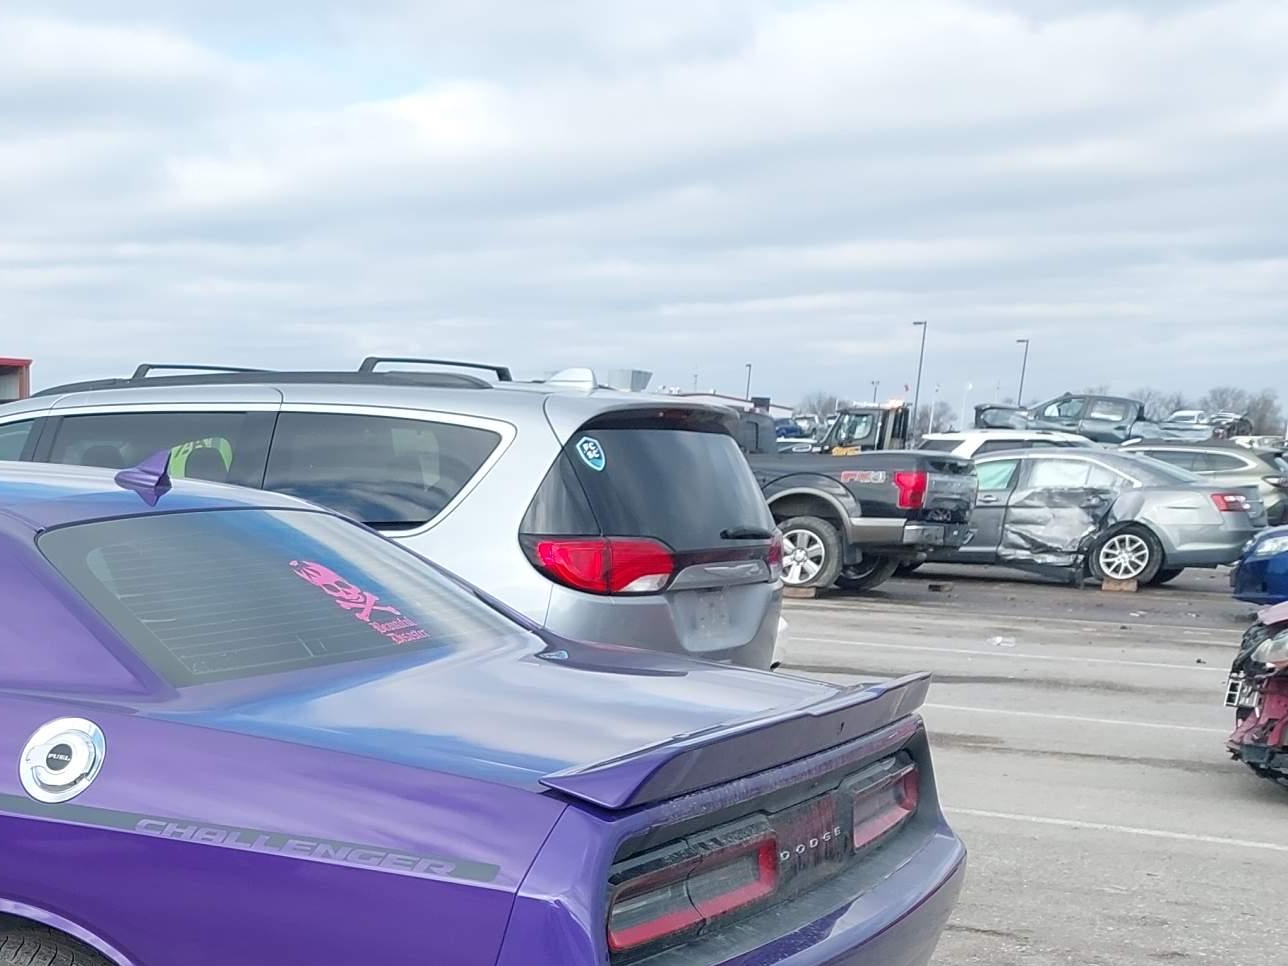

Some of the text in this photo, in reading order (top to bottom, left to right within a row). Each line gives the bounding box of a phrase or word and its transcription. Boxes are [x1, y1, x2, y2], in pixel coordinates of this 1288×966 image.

[47, 753, 71, 761] FUEL
[134, 818, 457, 876] CHALLENGER
[779, 826, 841, 861] DODGE
